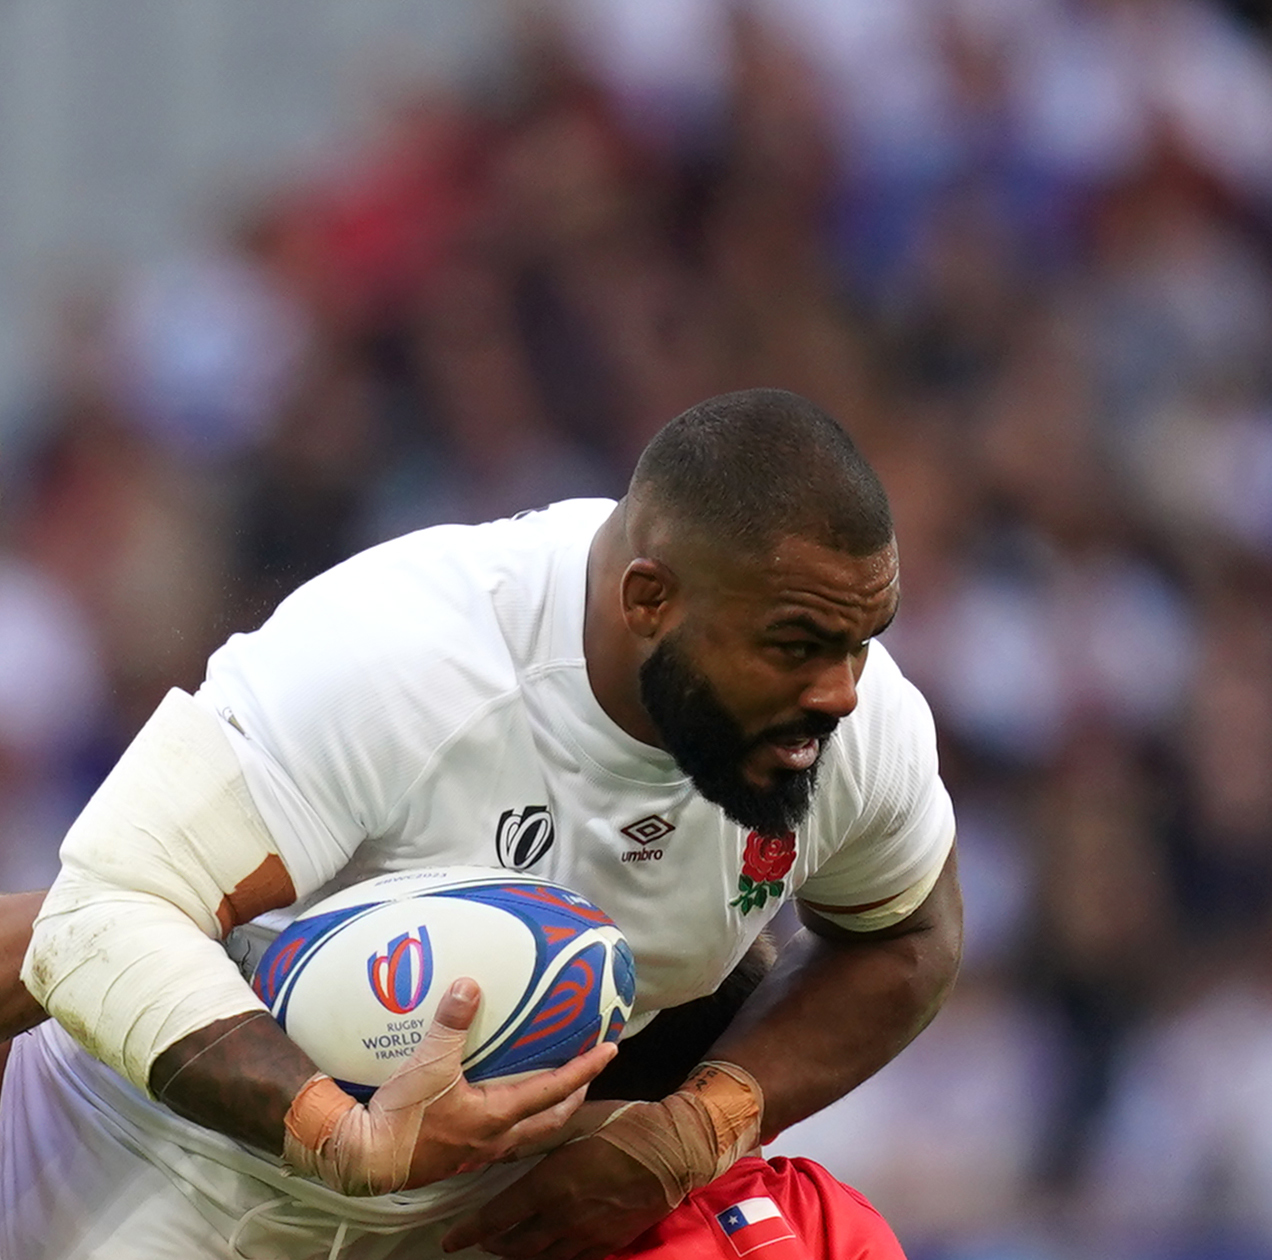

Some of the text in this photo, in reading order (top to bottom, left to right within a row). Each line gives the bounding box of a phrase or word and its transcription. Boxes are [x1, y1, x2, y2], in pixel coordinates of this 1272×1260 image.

[621, 848, 664, 863] umbro
[386, 1019, 425, 1033] RUGBY
[361, 1031, 422, 1050] WORLD
